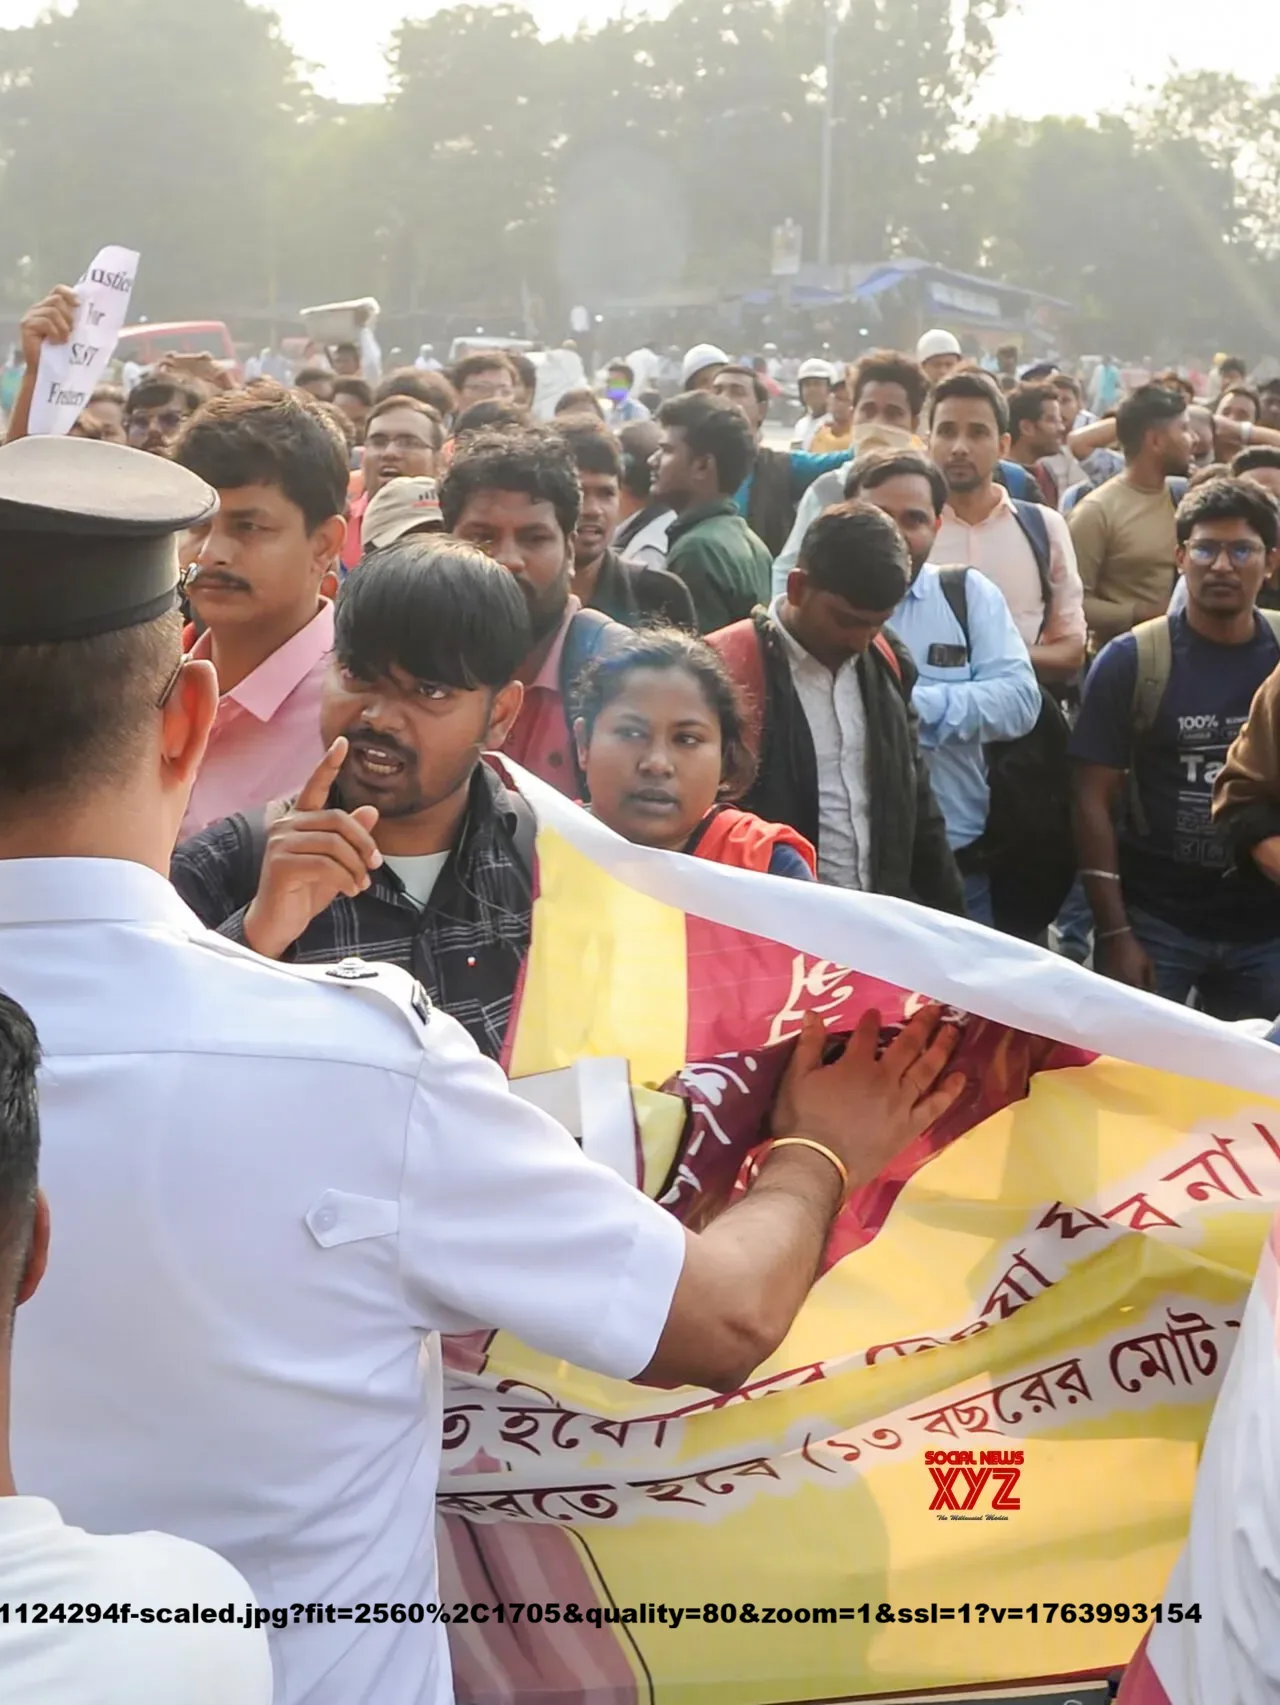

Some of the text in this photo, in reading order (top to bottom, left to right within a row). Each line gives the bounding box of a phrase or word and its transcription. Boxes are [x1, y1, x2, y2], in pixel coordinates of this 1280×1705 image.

[1178, 714, 1219, 730] 100%
[1180, 754, 1224, 784] Ta
[626, 1457, 782, 1507] হবে
[908, 1358, 1093, 1438] বছরের
[1109, 1307, 1217, 1396] মোট
